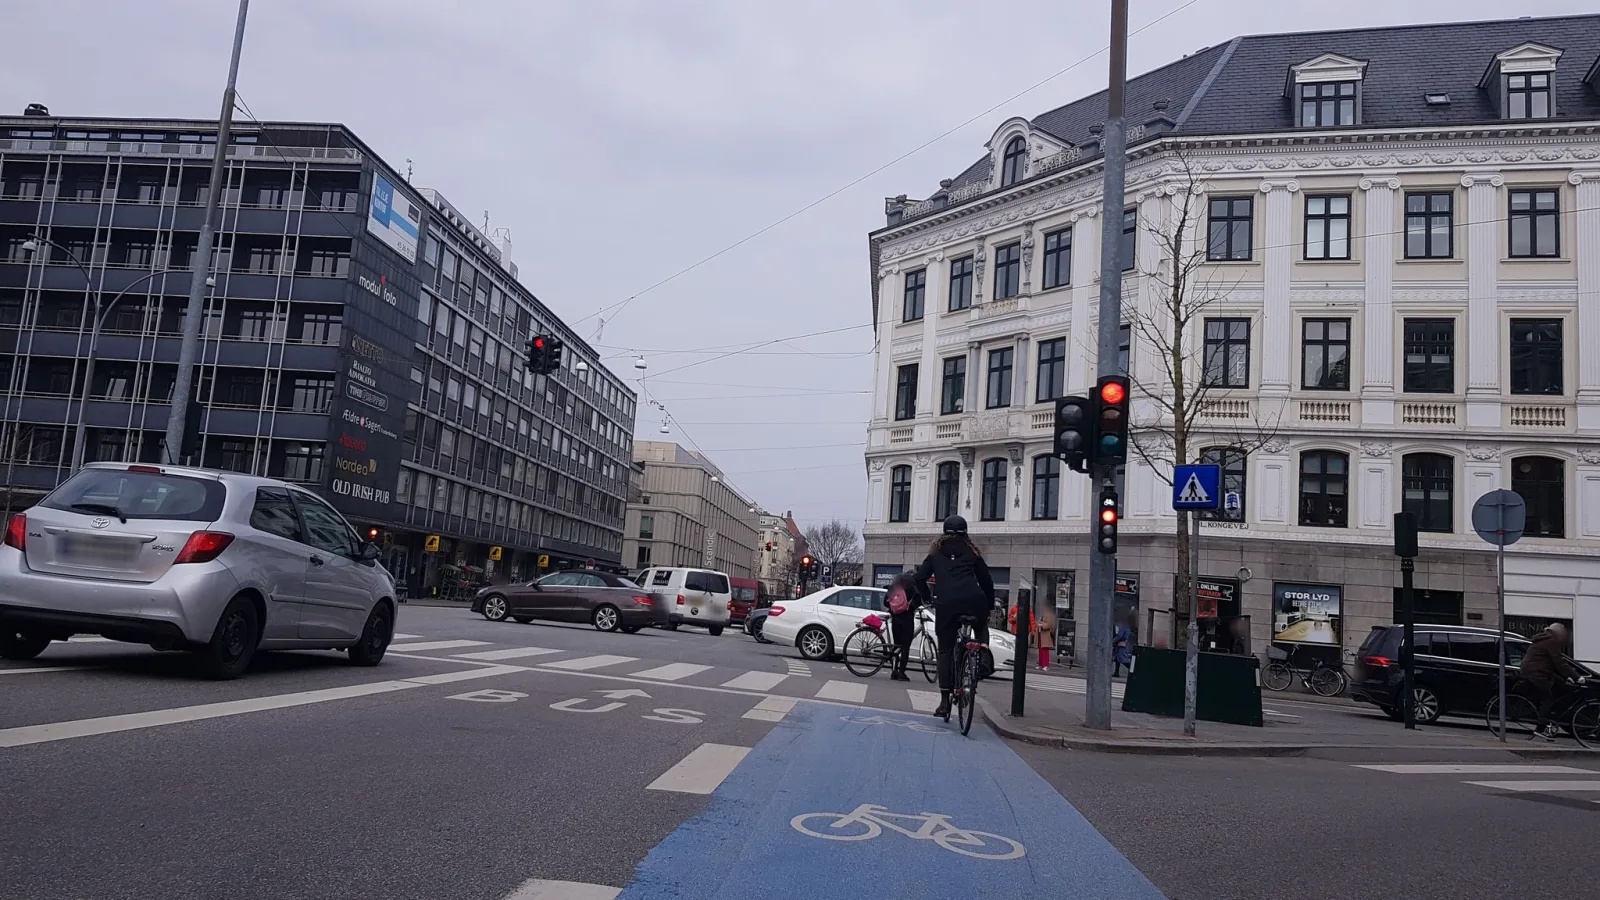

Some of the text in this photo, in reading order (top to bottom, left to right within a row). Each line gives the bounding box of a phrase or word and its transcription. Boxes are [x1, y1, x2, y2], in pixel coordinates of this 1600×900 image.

[359, 274, 397, 307] modul foto
[364, 417, 381, 434] Sagen
[335, 455, 368, 476] Nordea
[332, 478, 390, 504] OLD IRISH PUB
[1207, 521, 1250, 530] KONGEVEJ
[704, 532, 715, 567] Scandic
[823, 566, 830, 575] P
[1284, 591, 1331, 601] STOR LYD
[444, 689, 707, 723] BUS
